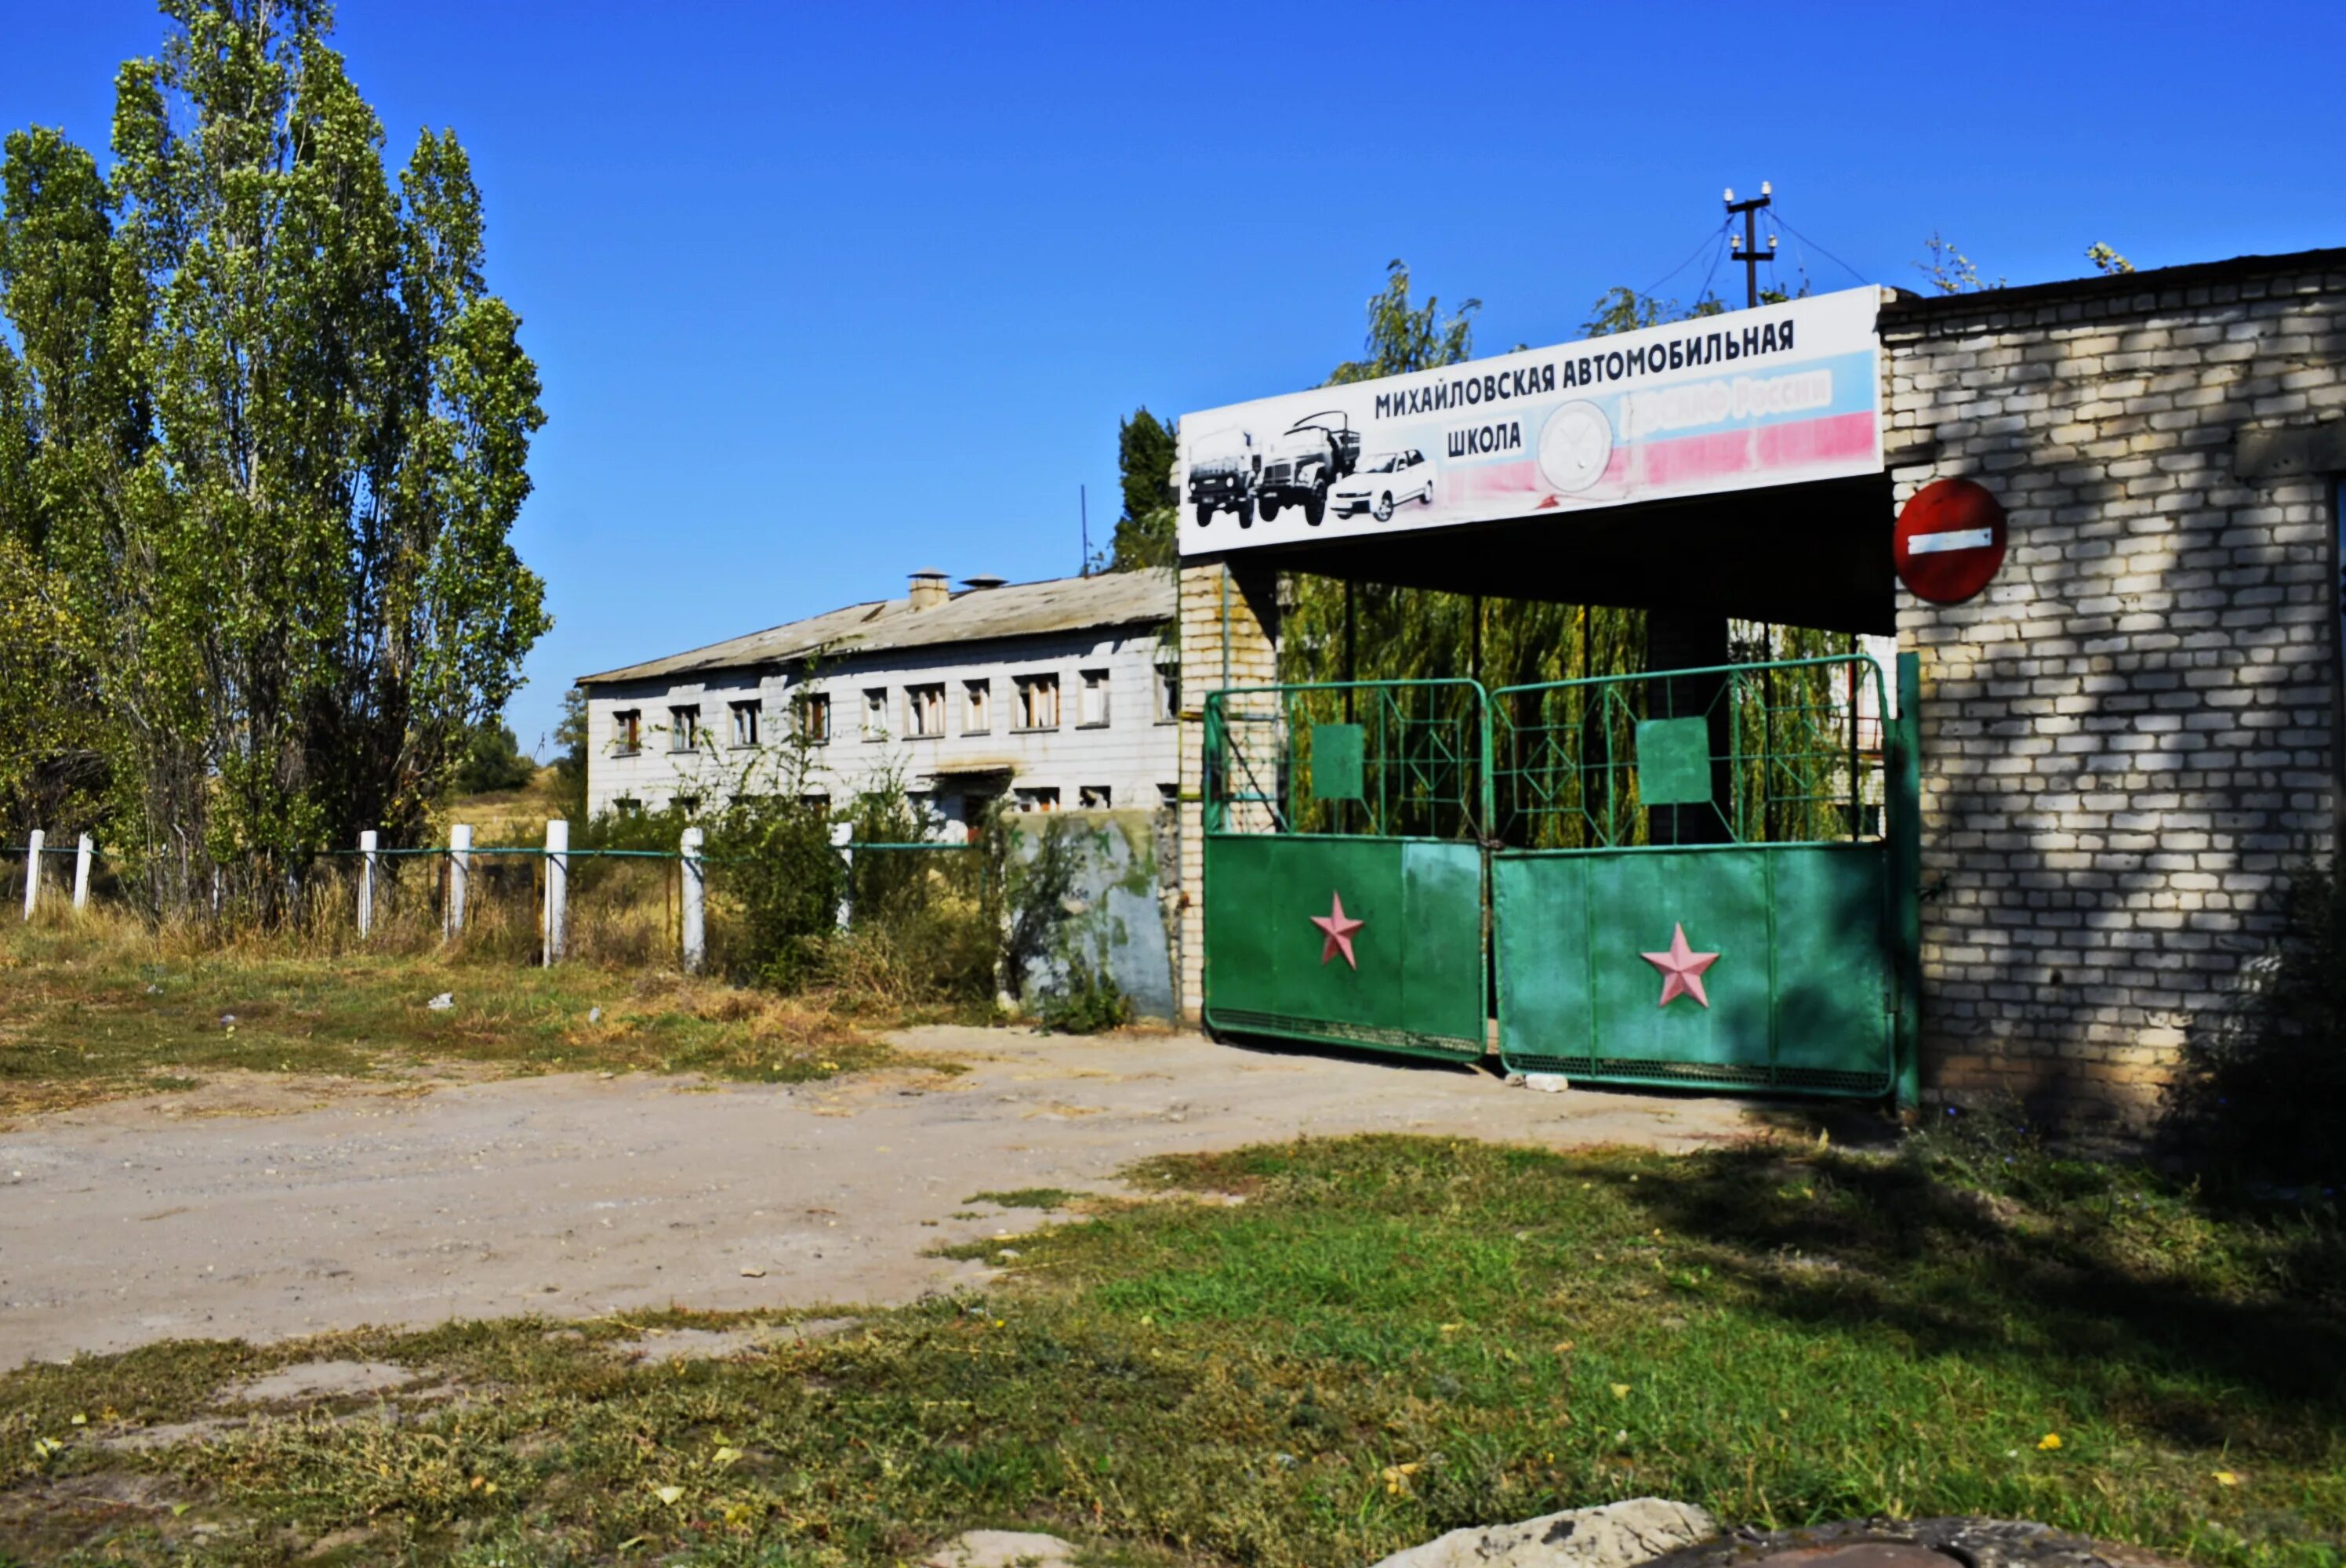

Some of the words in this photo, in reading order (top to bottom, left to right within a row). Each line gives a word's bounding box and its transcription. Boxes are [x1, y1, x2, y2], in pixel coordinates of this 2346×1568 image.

[1376, 363, 1555, 419] МИХАЙЛОВСКАЯ
[1563, 319, 1793, 388] АВТОМОБИЛЬНАЯ
[1448, 422, 1521, 457] ШКОЛА
